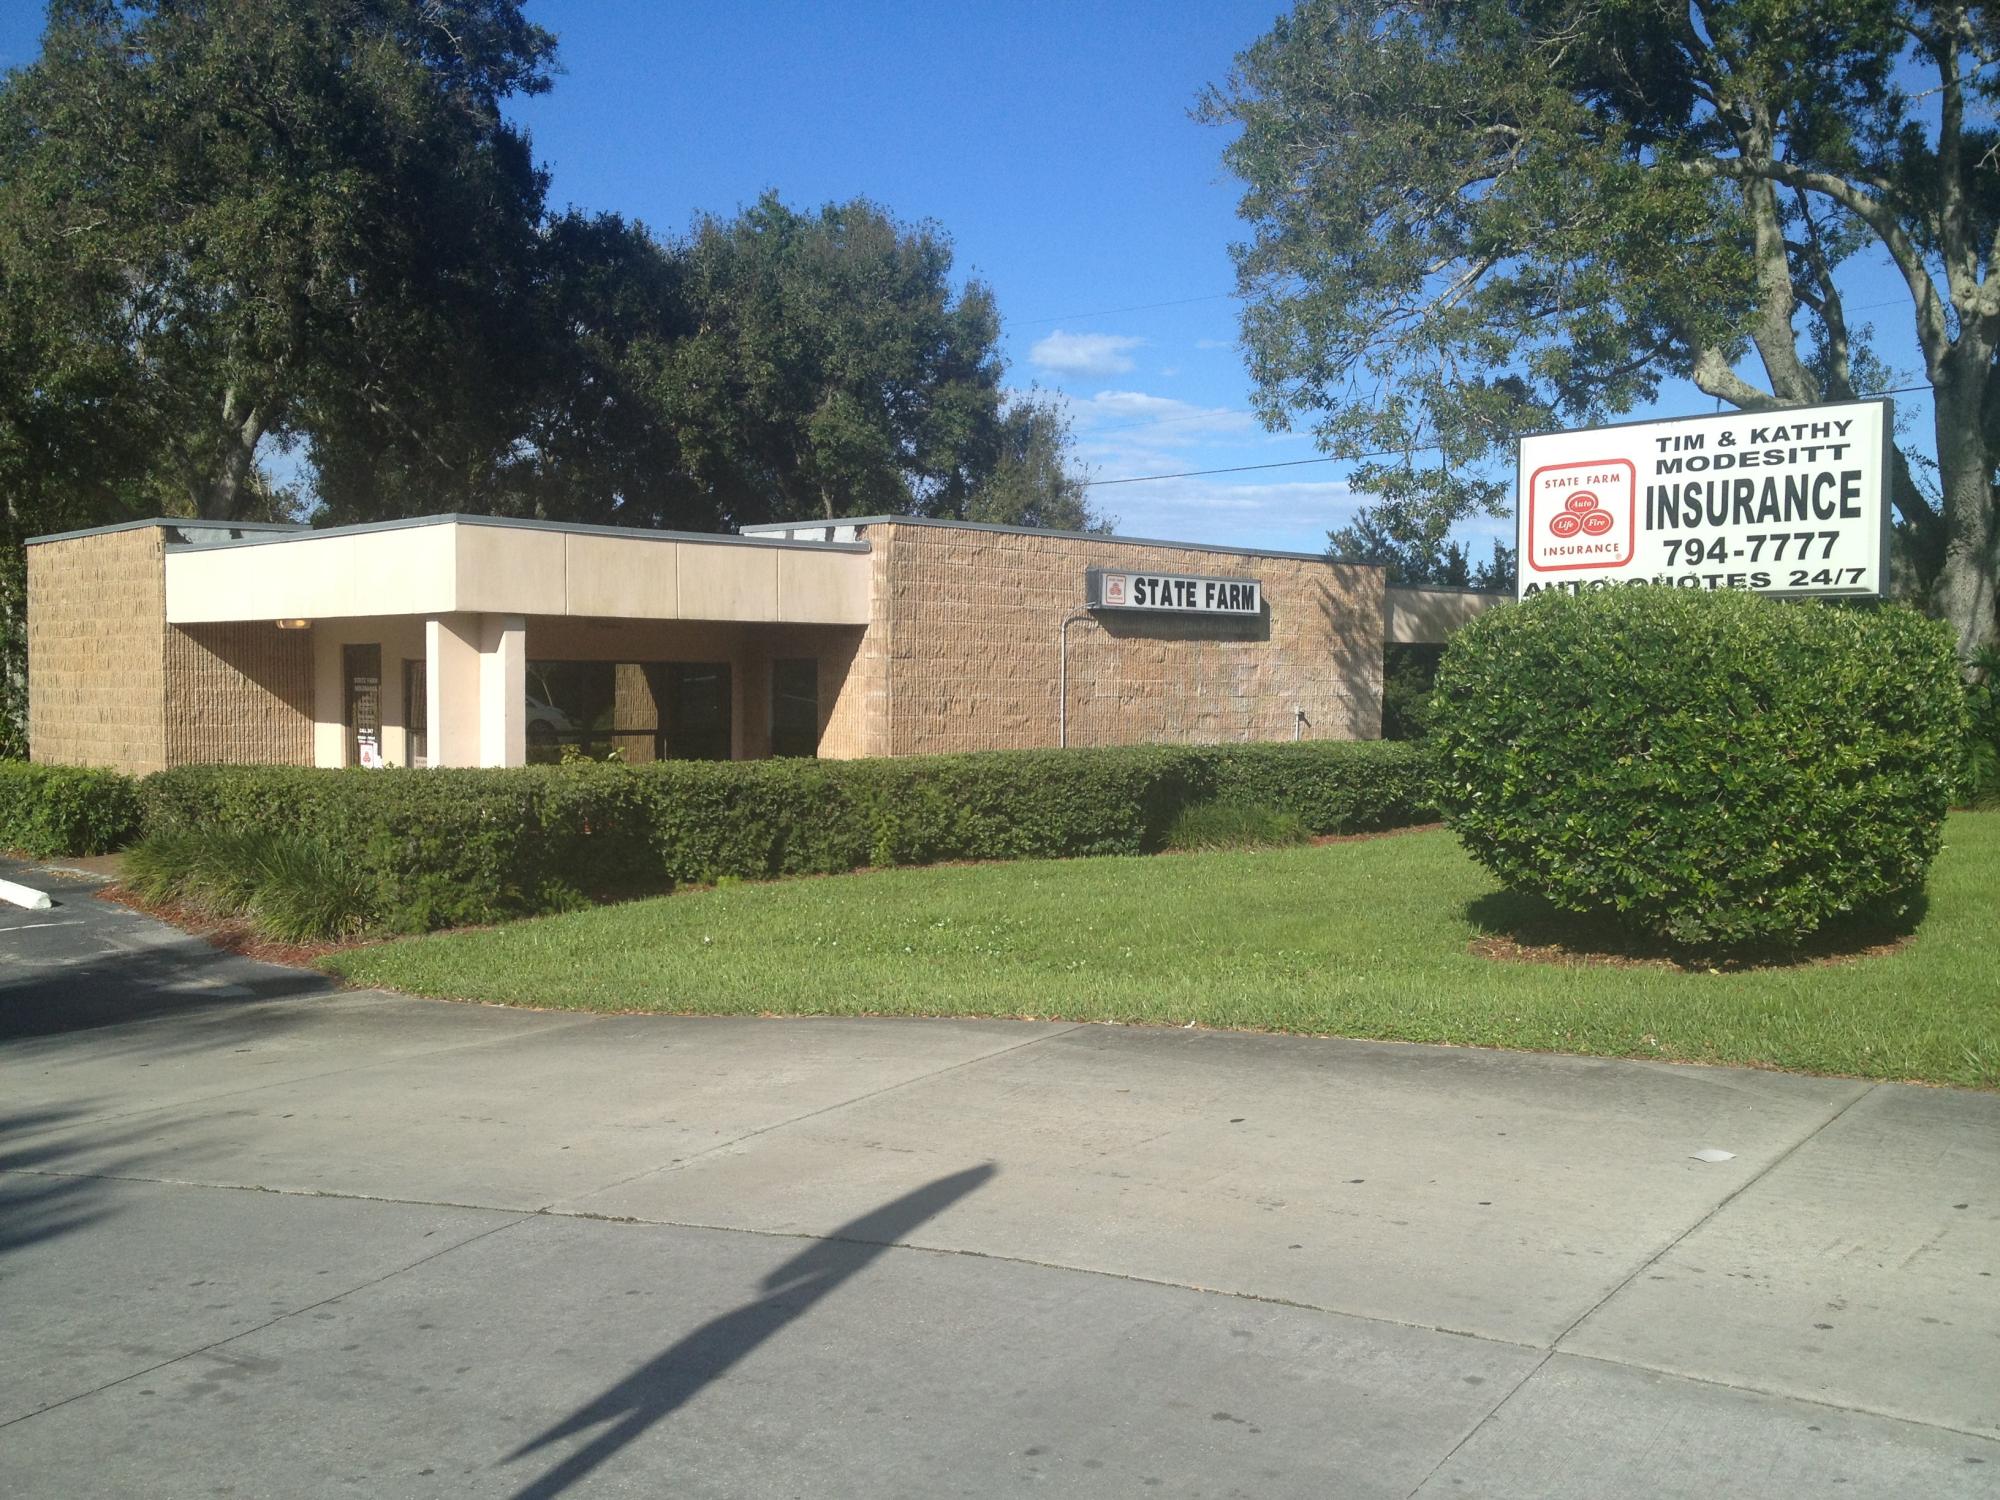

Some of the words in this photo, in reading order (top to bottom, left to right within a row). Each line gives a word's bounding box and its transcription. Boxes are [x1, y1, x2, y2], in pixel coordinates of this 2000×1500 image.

[1656, 434, 1704, 452] TIM
[1718, 431, 1736, 447] &
[1751, 420, 1853, 444] KATHY
[1656, 443, 1850, 474] MODESITT
[1545, 477, 1579, 489] STATE
[1586, 473, 1620, 485] FARM
[1573, 500, 1592, 508] Auto
[1646, 470, 1862, 530] INSURANCE
[1558, 521, 1574, 531] Life
[1589, 518, 1605, 527] Fire
[1543, 543, 1619, 556] INSURANCE
[1663, 531, 1840, 566] 794-7777
[1789, 568, 1867, 586] 24/7
[1134, 577, 1197, 607] STATE
[1205, 583, 1255, 611] FARM
